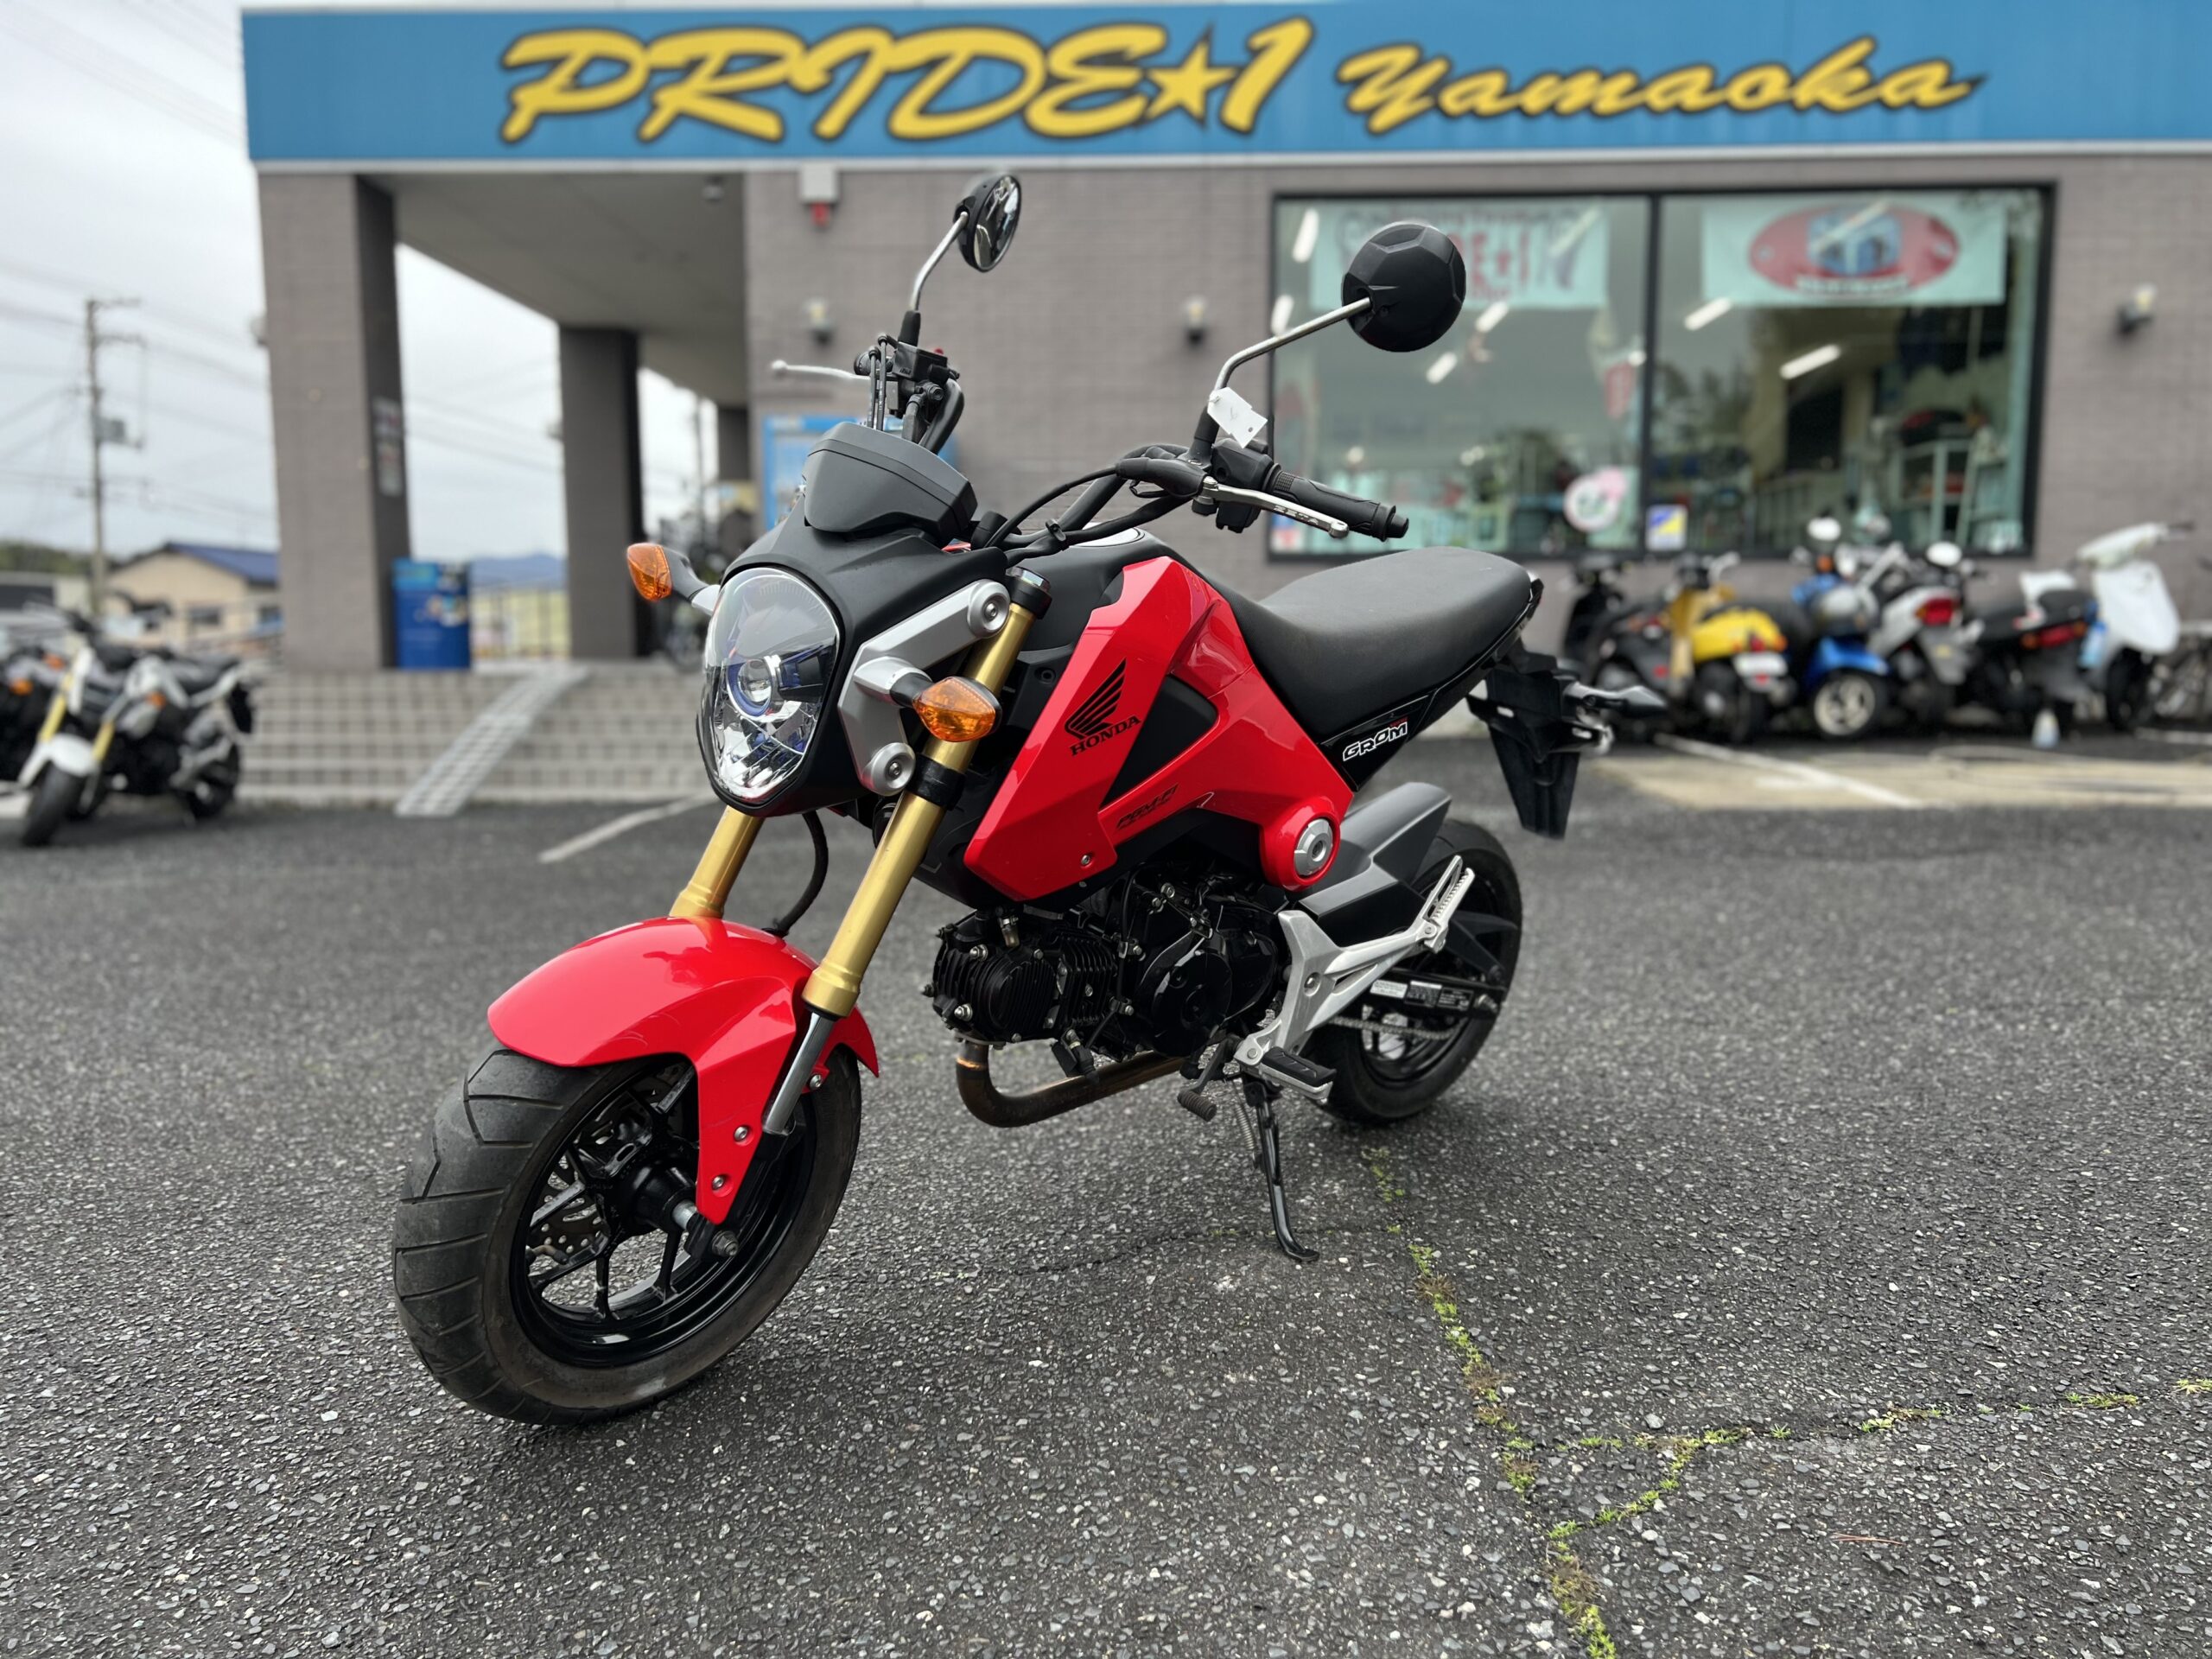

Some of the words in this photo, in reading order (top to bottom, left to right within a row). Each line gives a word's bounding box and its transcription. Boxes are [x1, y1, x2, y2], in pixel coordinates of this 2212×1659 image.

[1337, 35, 1987, 138] Yamaoka
[1069, 715, 1141, 757] HONDA
[1342, 721, 1408, 762] GROM
